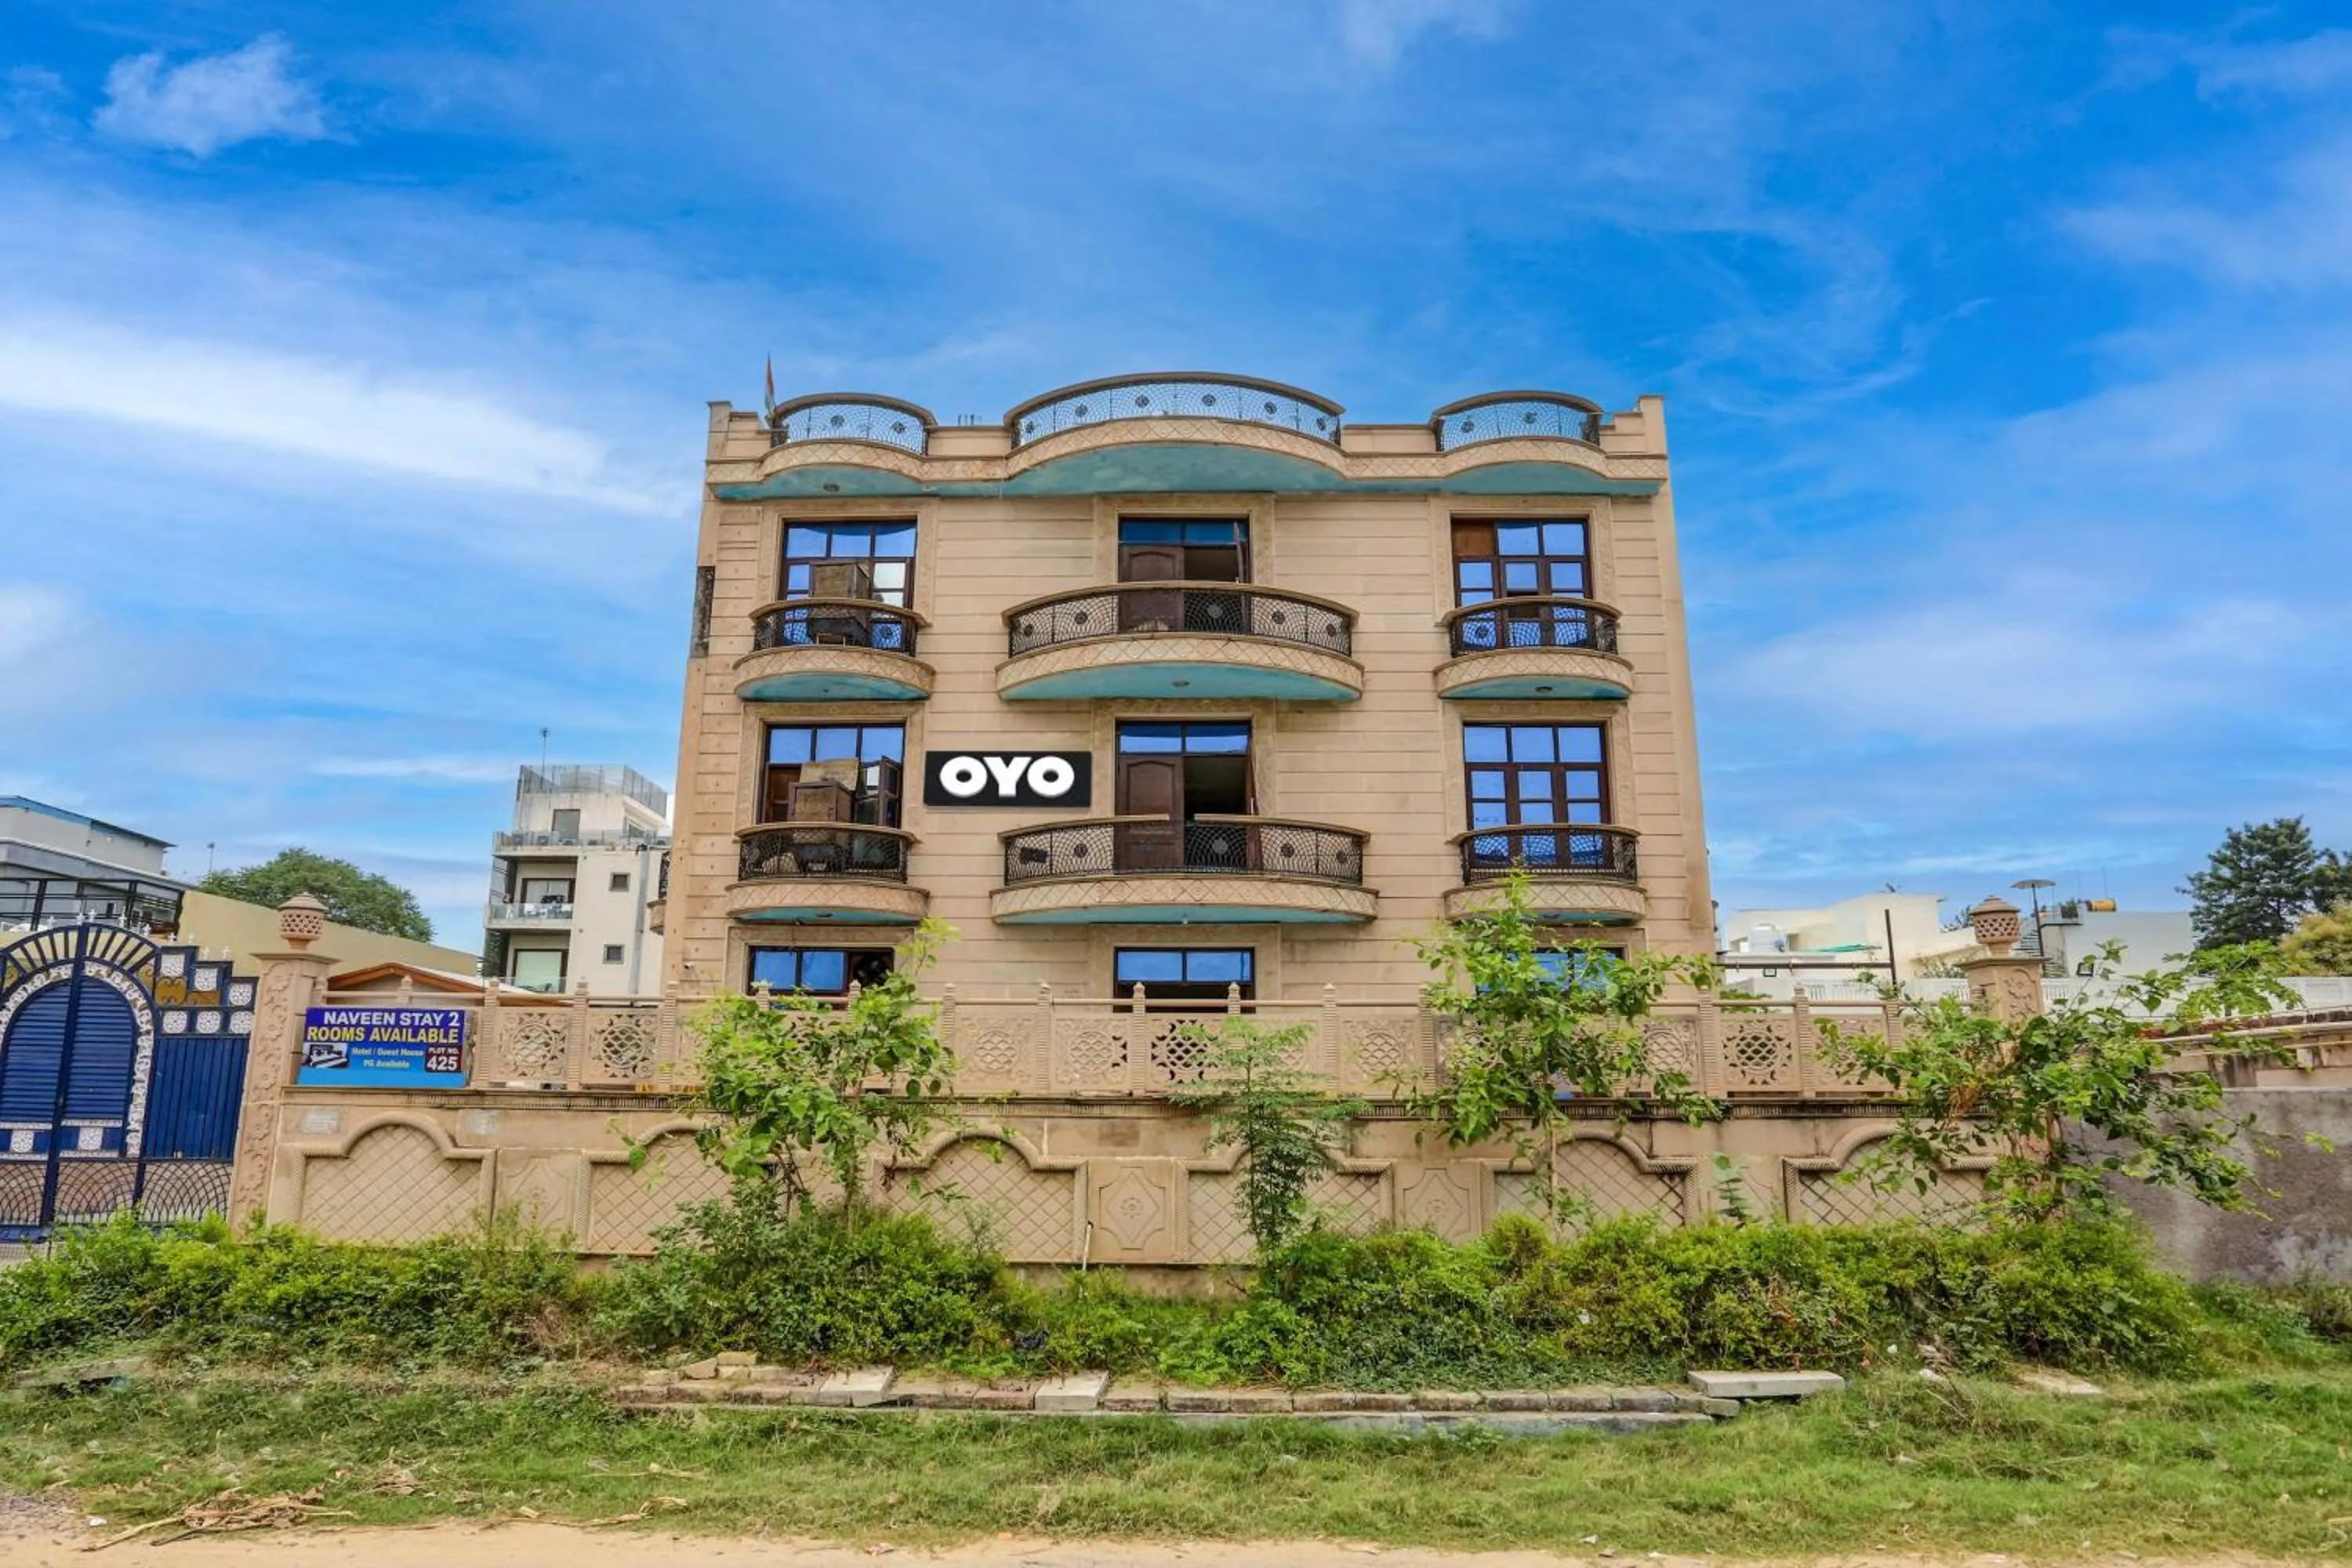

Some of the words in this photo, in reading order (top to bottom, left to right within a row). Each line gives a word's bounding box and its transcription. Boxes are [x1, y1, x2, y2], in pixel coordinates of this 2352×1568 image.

[939, 756, 1075, 798] OYO
[324, 1011, 396, 1025] NAVEEN
[399, 1012, 445, 1026] STAY
[448, 1012, 460, 1026] 2
[307, 1027, 365, 1041] ROOMS
[369, 1028, 459, 1043] AVAILABLE
[377, 1047, 400, 1057] Guest
[401, 1047, 424, 1057] House
[426, 1055, 459, 1070] 425
